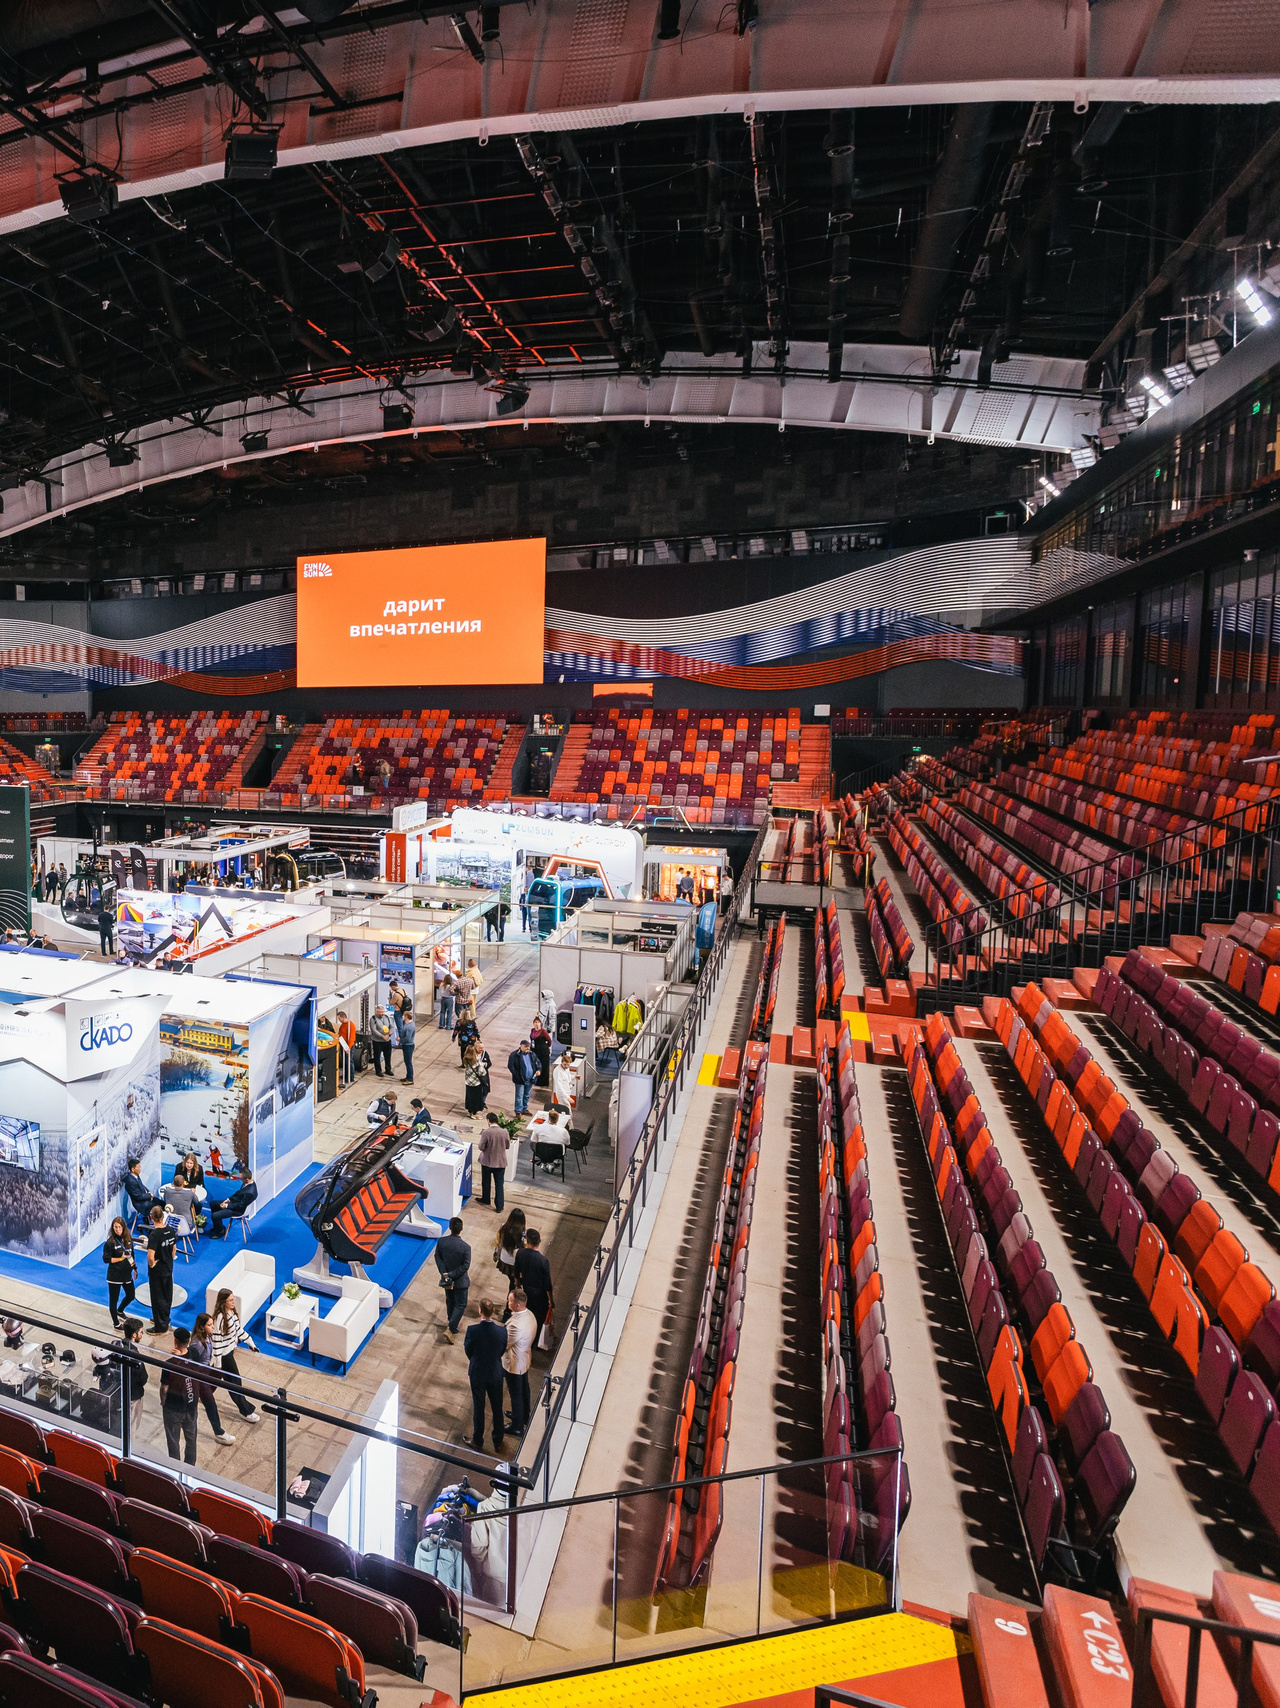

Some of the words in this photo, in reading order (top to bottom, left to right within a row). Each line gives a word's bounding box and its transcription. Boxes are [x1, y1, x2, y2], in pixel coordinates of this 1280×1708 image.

[304, 563, 318, 571] FUN
[383, 597, 445, 617] дарит
[349, 619, 482, 637] впечатления
[994, 1617, 1028, 1636] 9
[1082, 1628, 1130, 1681] C23
